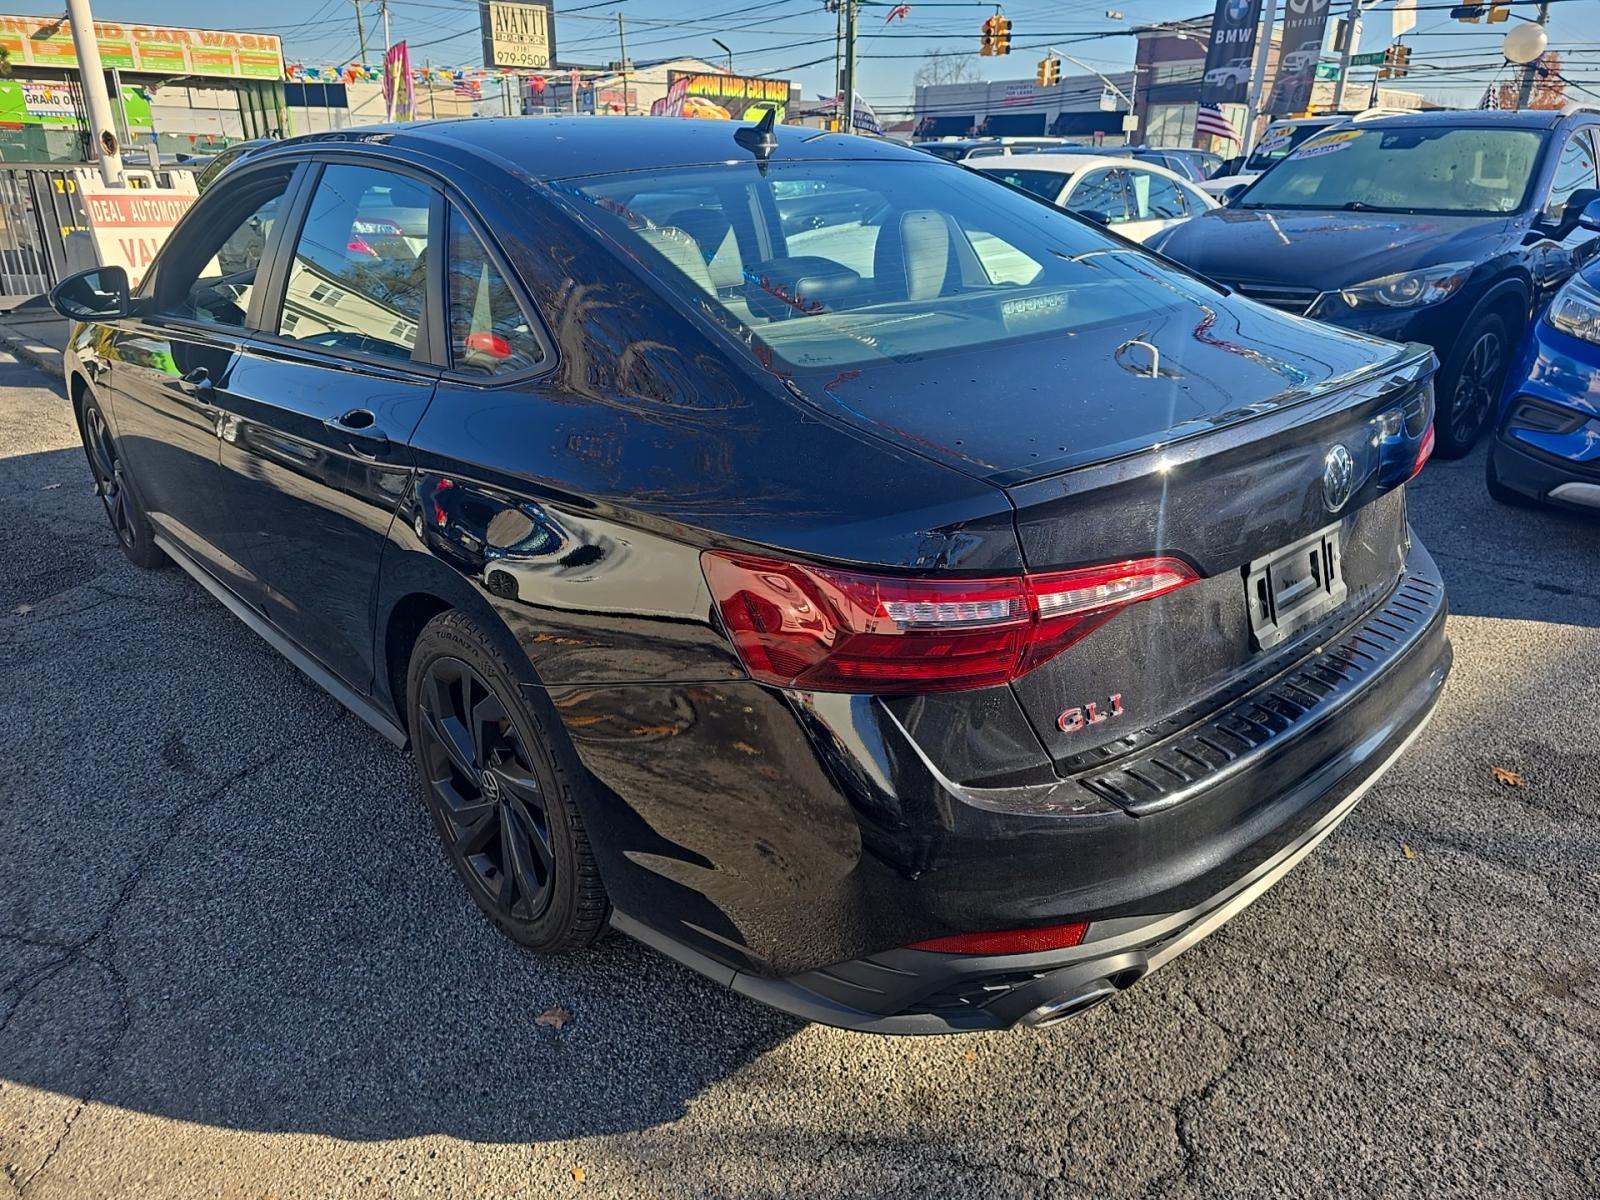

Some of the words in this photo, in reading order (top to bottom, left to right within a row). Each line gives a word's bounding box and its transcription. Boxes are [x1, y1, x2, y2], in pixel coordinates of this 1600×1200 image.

[496, 5, 545, 35] AVANTI
[131, 26, 192, 45] CAR
[198, 31, 277, 51] WASH
[1215, 28, 1252, 44] BMW
[497, 51, 547, 66] 979-9500
[25, 94, 60, 105] GRAND
[436, 631, 479, 657] TURANZA
[1055, 693, 1124, 733] GLI
